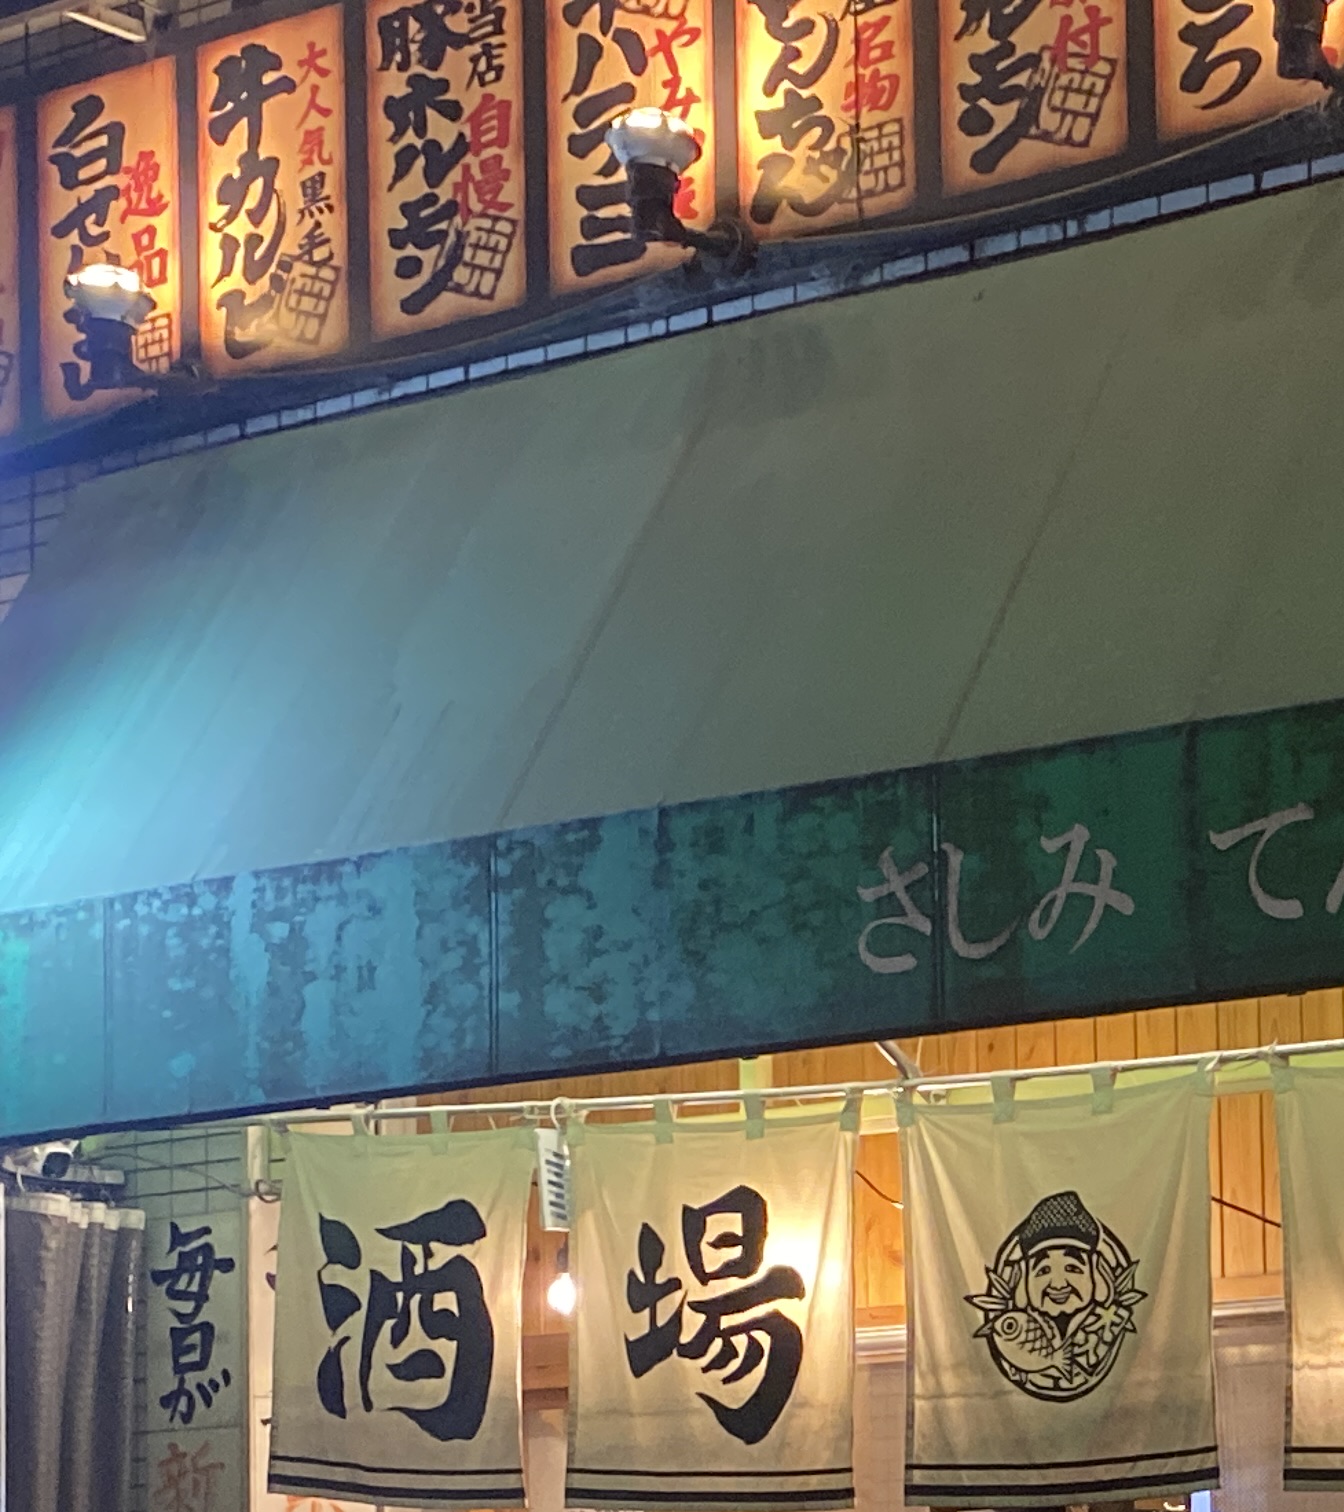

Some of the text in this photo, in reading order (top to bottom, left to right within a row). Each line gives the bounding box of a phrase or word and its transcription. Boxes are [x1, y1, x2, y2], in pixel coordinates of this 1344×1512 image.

[120, 150, 169, 288] 逸品
[208, 44, 297, 359] 牛カルビ
[562, 0, 648, 277] ハラミ
[856, 821, 1136, 975] さしみ
